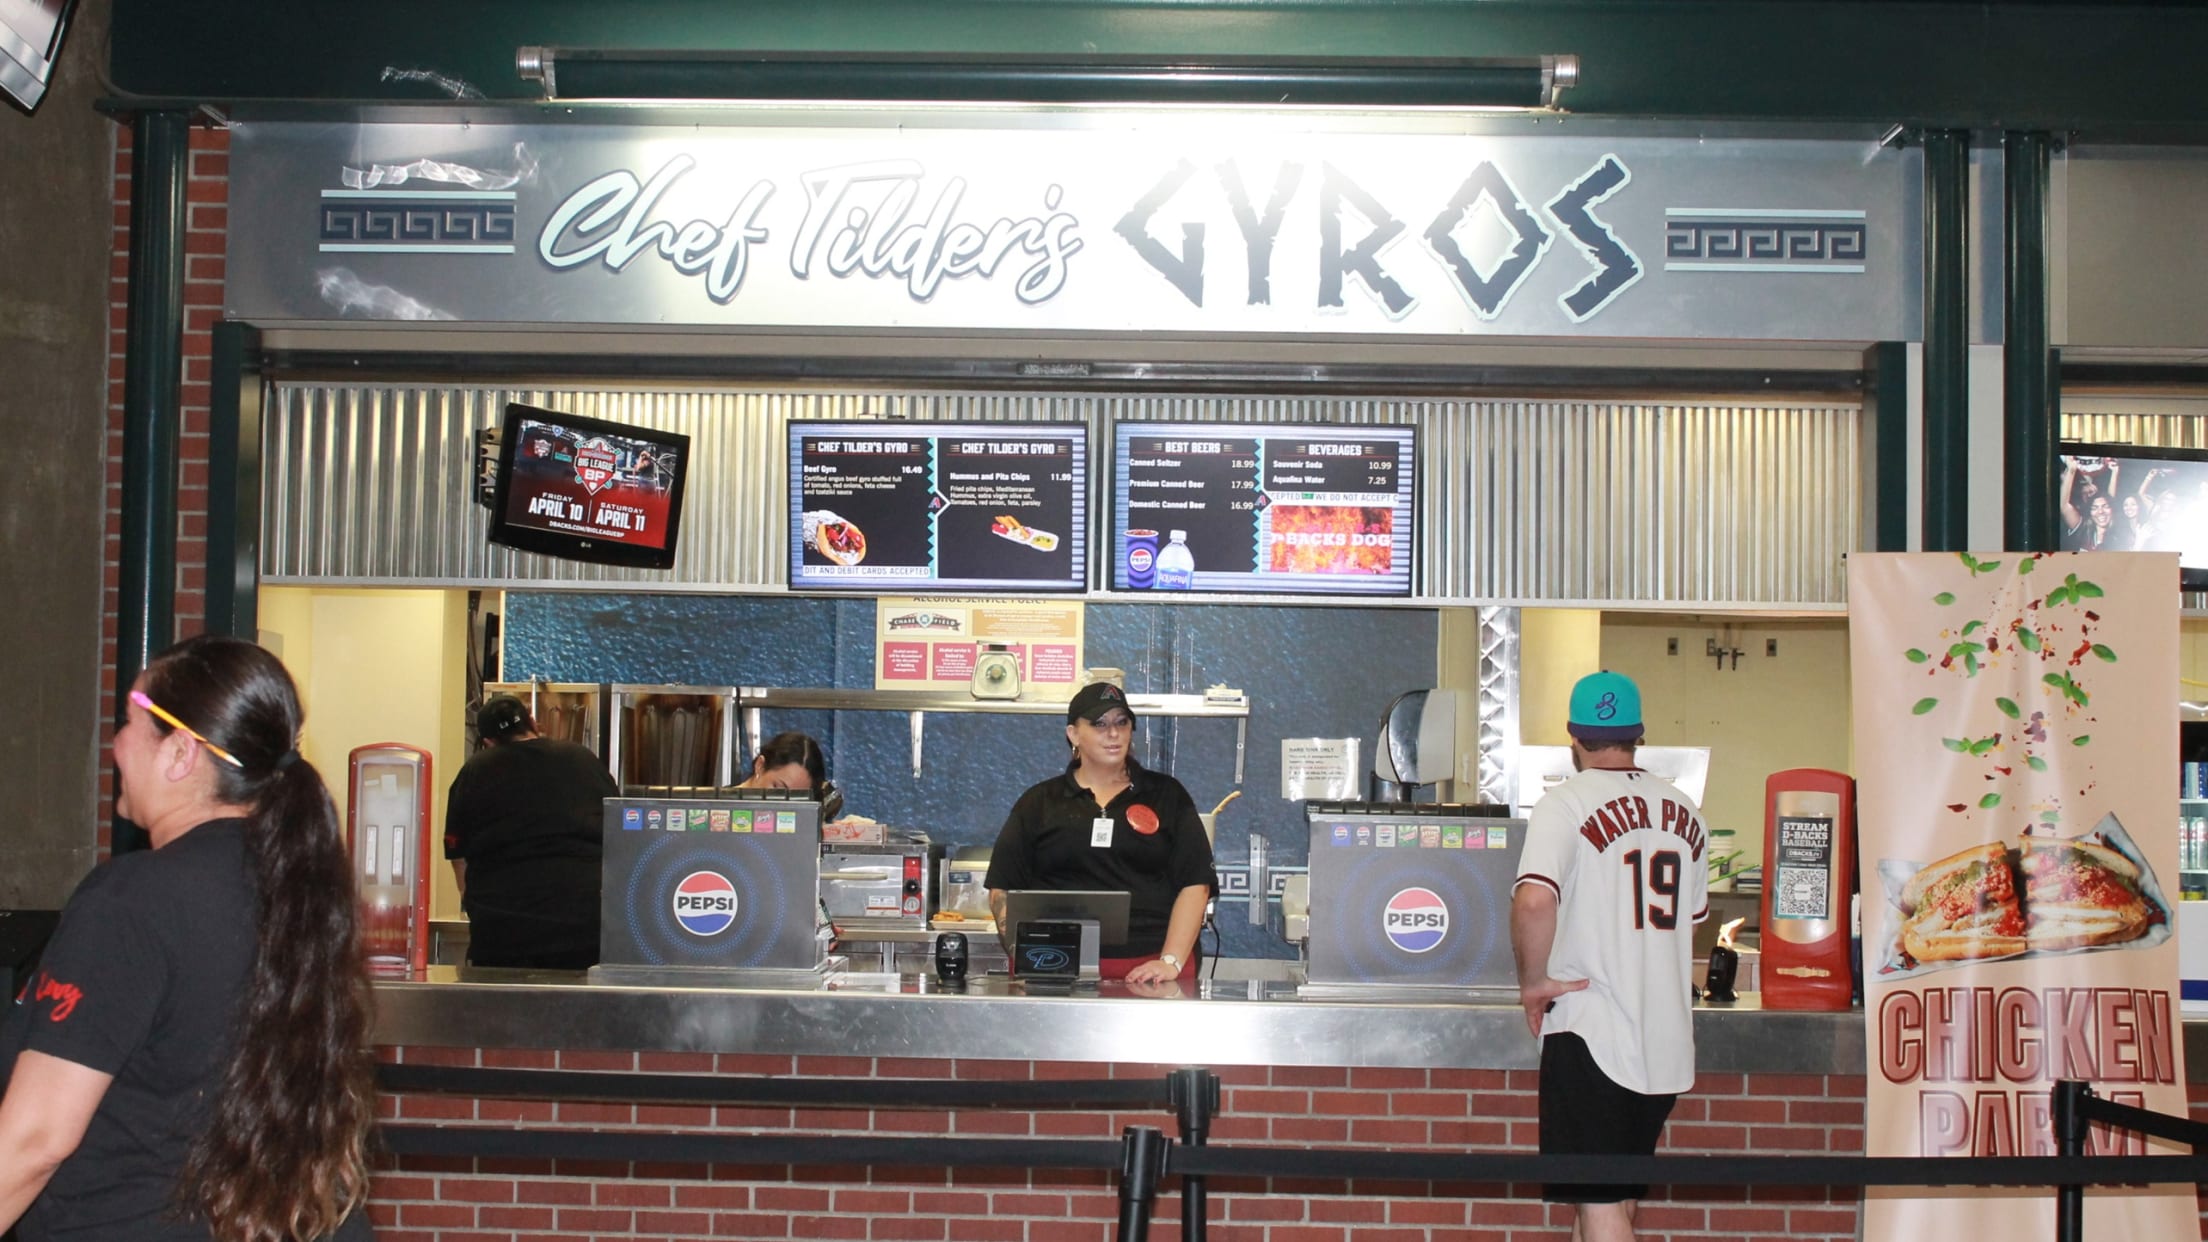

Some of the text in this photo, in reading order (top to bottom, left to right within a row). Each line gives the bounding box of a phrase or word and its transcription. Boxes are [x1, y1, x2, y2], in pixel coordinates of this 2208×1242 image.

[536, 152, 1645, 324] Chef Tilder's GYROS
[818, 442, 908, 454] CHEF TILDER'S GYRO
[962, 443, 1054, 454] CHEF TILDER'S GYRO
[1165, 442, 1220, 453] BEST BEERS
[1308, 444, 1362, 456] BEVERAGES
[1130, 458, 1155, 466] Canned
[1231, 460, 1254, 468] 18.99
[1369, 461, 1392, 470] 10.99
[804, 465, 819, 473] Beef
[1011, 474, 1030, 482] Chips
[1368, 476, 1386, 485] 7.25
[1130, 480, 1160, 488] Premium
[1161, 480, 1186, 488] Canned
[1232, 480, 1254, 489] 17.99
[542, 492, 573, 502] FRIDAY
[1330, 494, 1340, 502] DO
[1343, 494, 1358, 502] NOT
[1361, 494, 1390, 502] ACCEPT
[528, 497, 584, 521] APRIL 10
[600, 502, 644, 514] SATURDAY
[1129, 500, 1160, 508] Domestic
[1231, 502, 1254, 510] 16.99
[595, 508, 646, 532] APRIL 11
[1352, 534, 1390, 546] DOG
[820, 566, 836, 575] AND
[838, 567, 858, 576] DEBIT
[862, 568, 888, 576] CARDS
[890, 568, 928, 576] ACCEPTED
[1580, 795, 1652, 854] WATER
[1783, 822, 1828, 832] STREAM
[1783, 830, 1828, 840] D-BACKS
[1782, 840, 1828, 848] BASEBALL
[1624, 848, 1681, 930] 19
[678, 896, 734, 910] PEPSI
[1388, 913, 1444, 928] PEPSI
[1879, 986, 2176, 1085] CHICKEN
